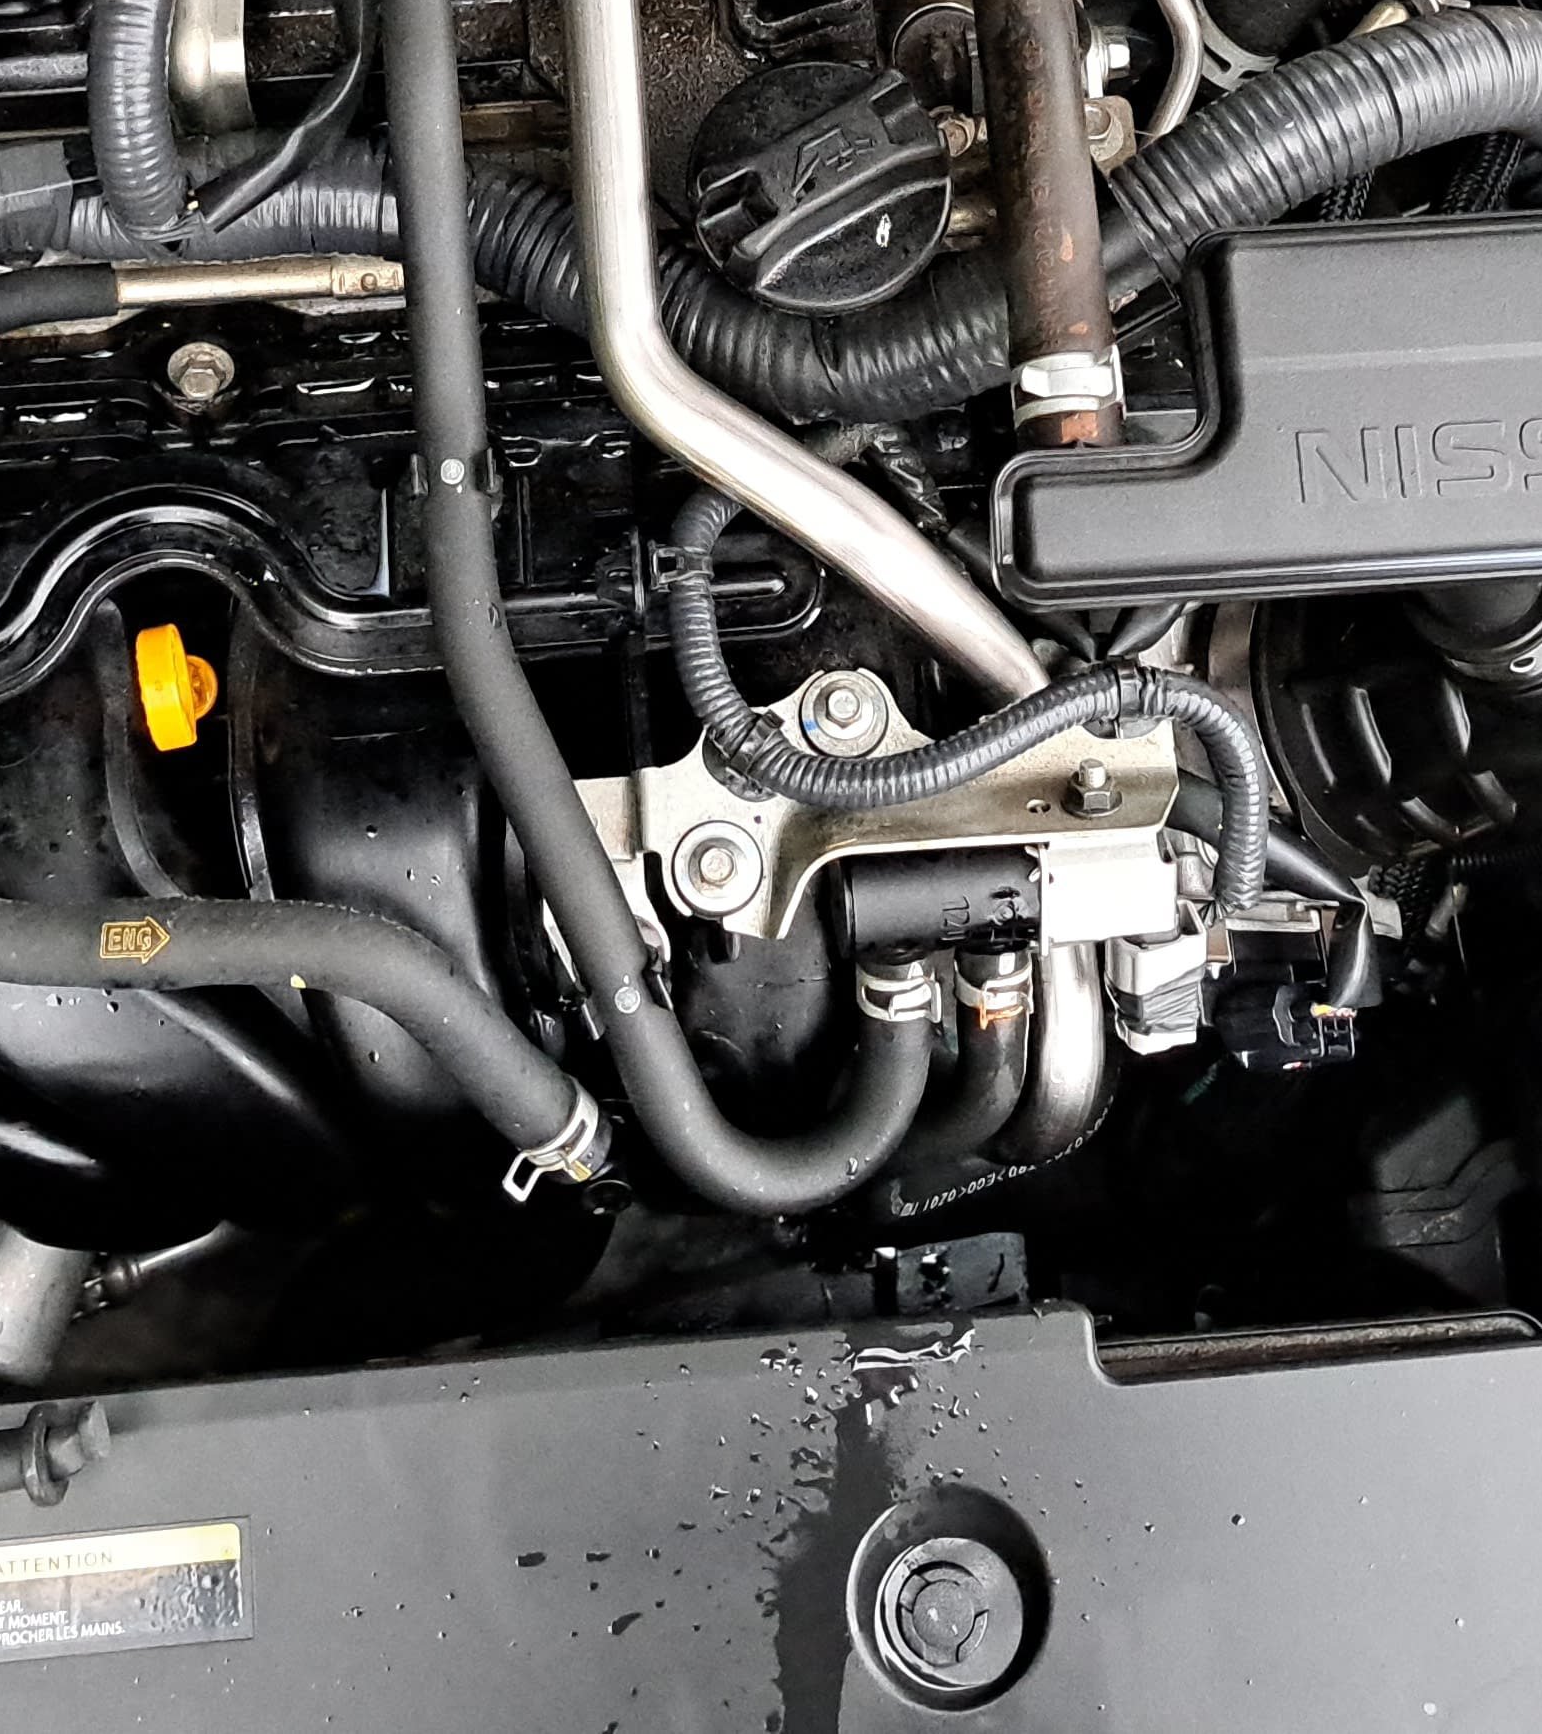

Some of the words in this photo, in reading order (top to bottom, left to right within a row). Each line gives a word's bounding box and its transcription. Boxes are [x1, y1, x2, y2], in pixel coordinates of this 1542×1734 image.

[108, 928, 154, 954] ENG
[9, 1611, 68, 1628] MOMENT.
[57, 1624, 79, 1639] LES
[81, 1621, 125, 1637] MAINS.
